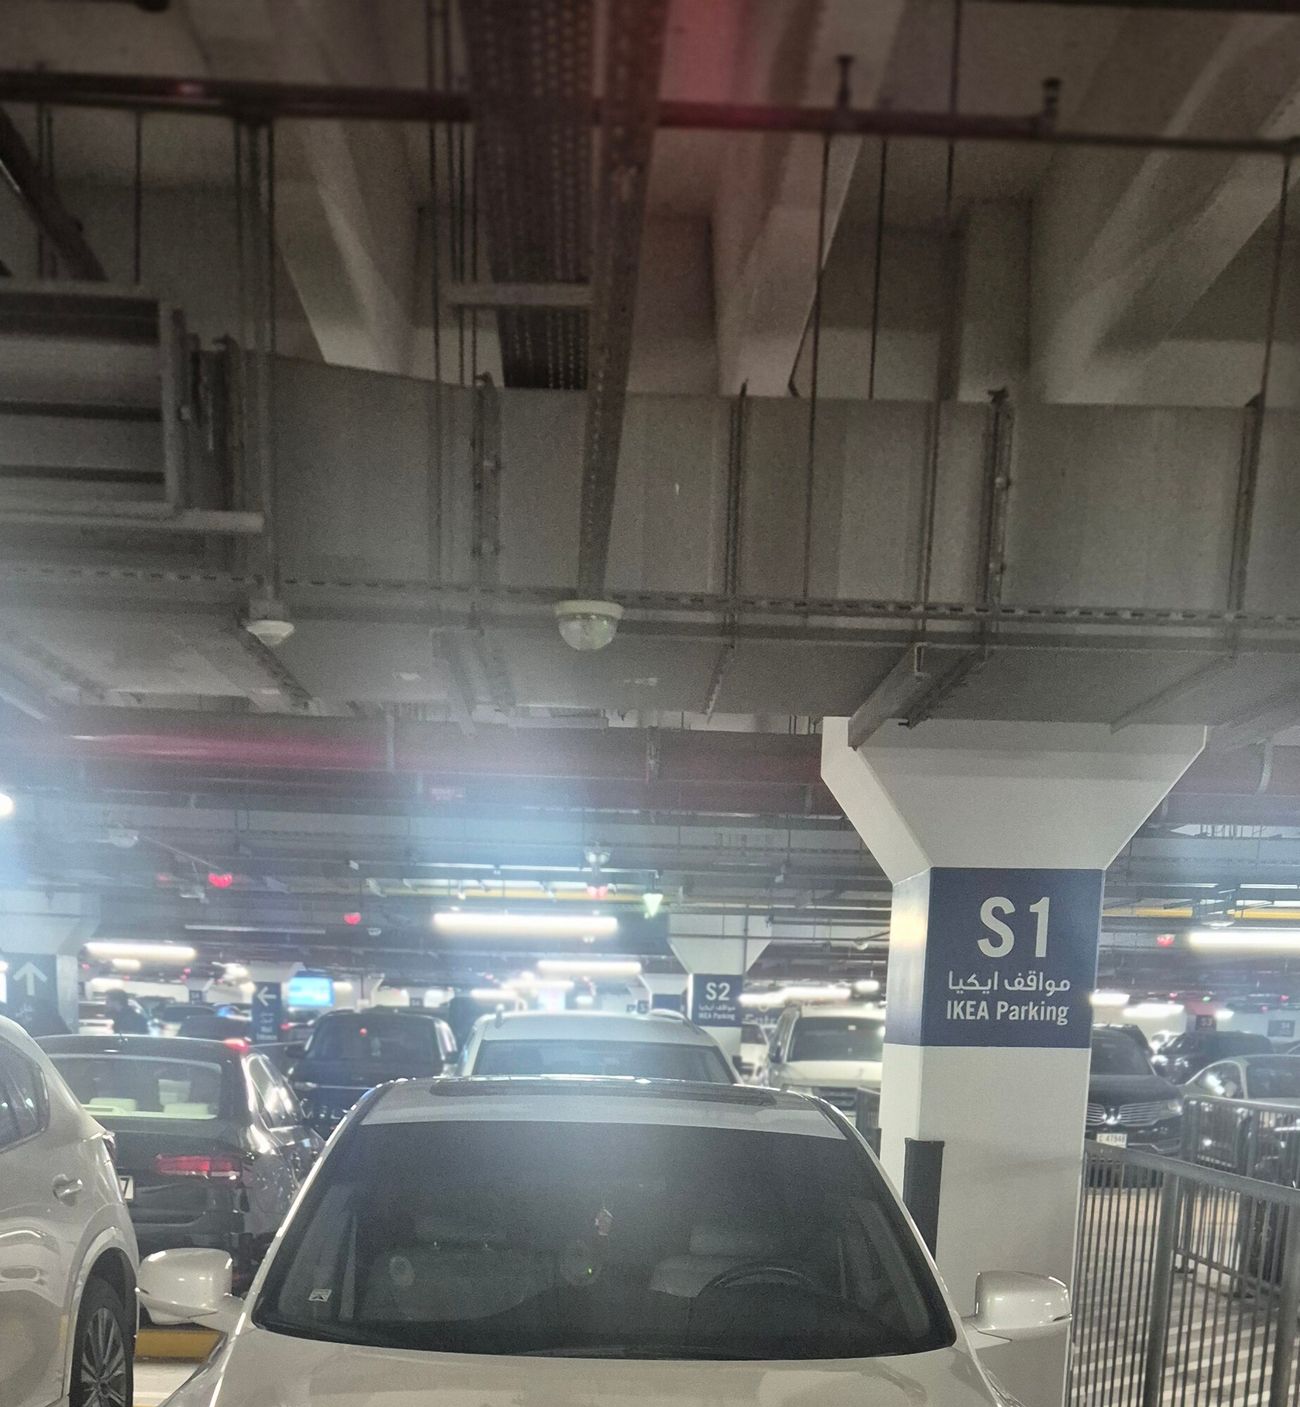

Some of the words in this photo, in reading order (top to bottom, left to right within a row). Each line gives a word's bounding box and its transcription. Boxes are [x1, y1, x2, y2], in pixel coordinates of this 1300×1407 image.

[977, 896, 1050, 958] S1
[705, 982, 731, 1001] S2
[948, 970, 999, 995] ايكيا
[1004, 970, 1071, 997] مواقف
[946, 1000, 990, 1020] IKEA
[996, 1000, 1070, 1026] Parking
